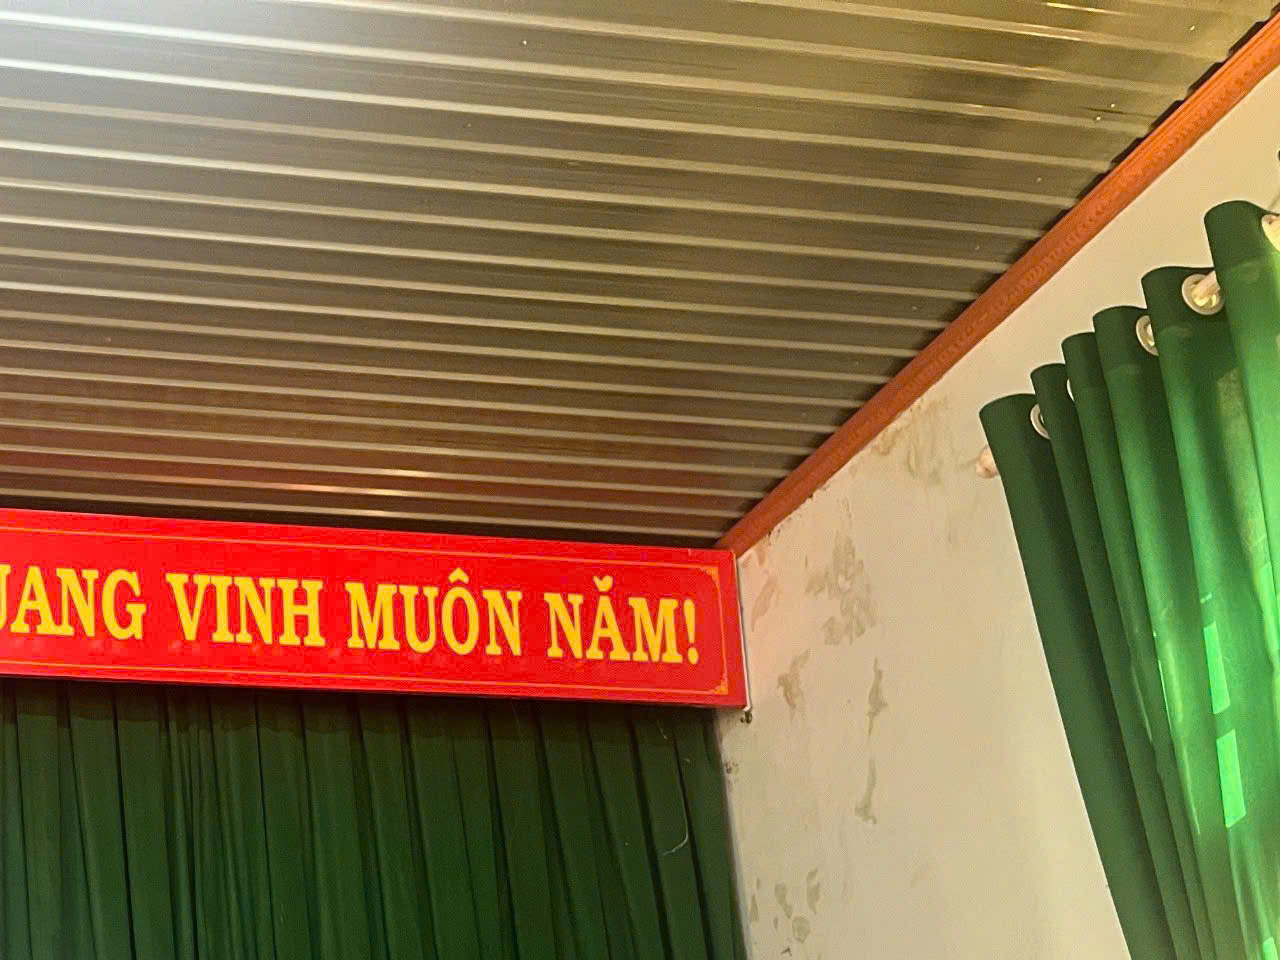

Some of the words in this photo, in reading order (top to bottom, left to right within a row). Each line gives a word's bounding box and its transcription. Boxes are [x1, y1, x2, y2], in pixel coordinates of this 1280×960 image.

[166, 573, 325, 646] VINH
[346, 568, 522, 655] MUÔN
[544, 577, 699, 664] NĂM!
